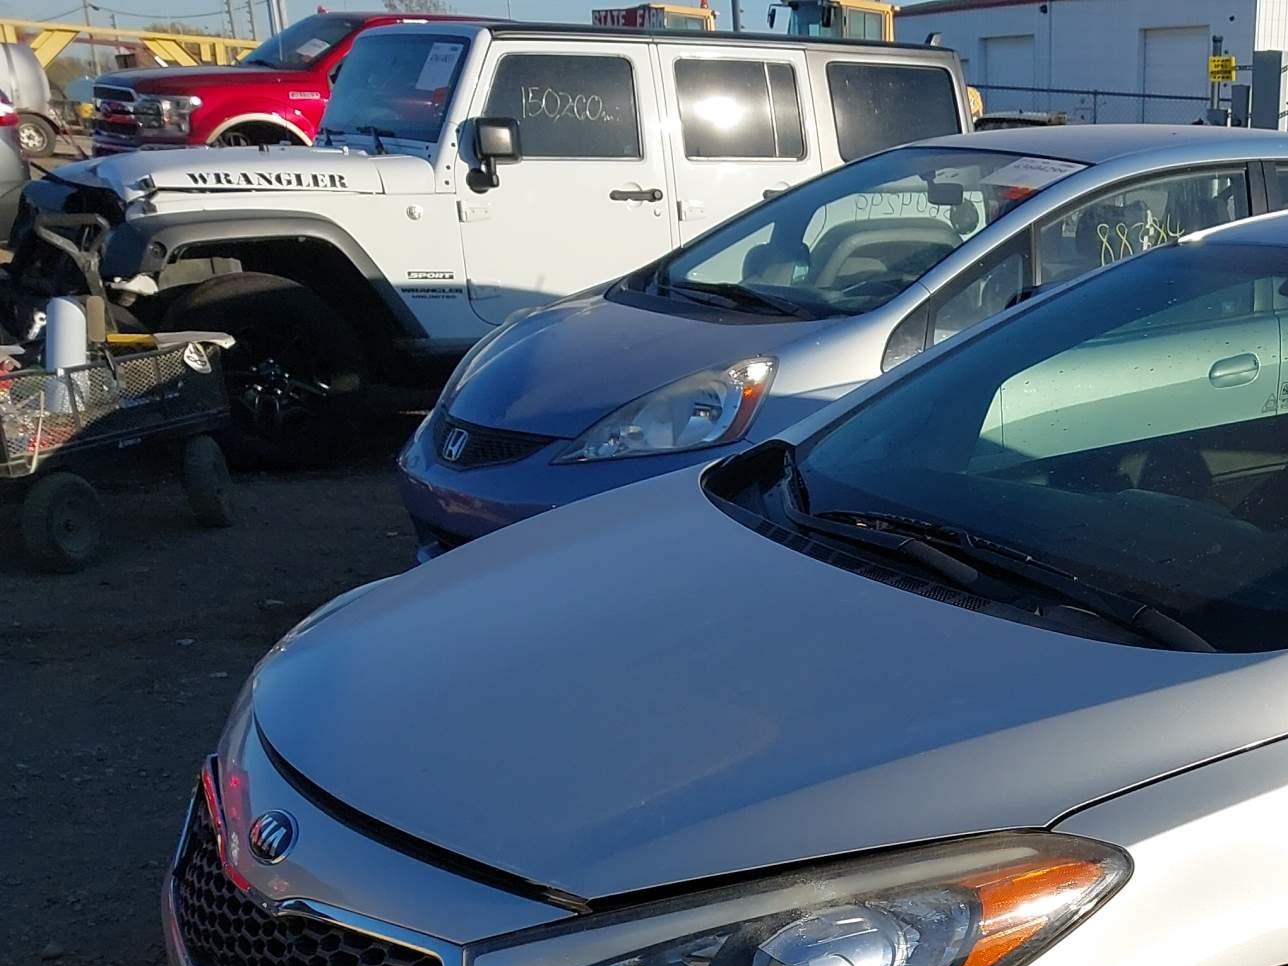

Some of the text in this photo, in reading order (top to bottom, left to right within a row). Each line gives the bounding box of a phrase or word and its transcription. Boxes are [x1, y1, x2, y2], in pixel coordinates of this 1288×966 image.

[592, 10, 627, 27] STATE
[186, 172, 349, 189] WRANGLER
[251, 814, 287, 857] KIA
